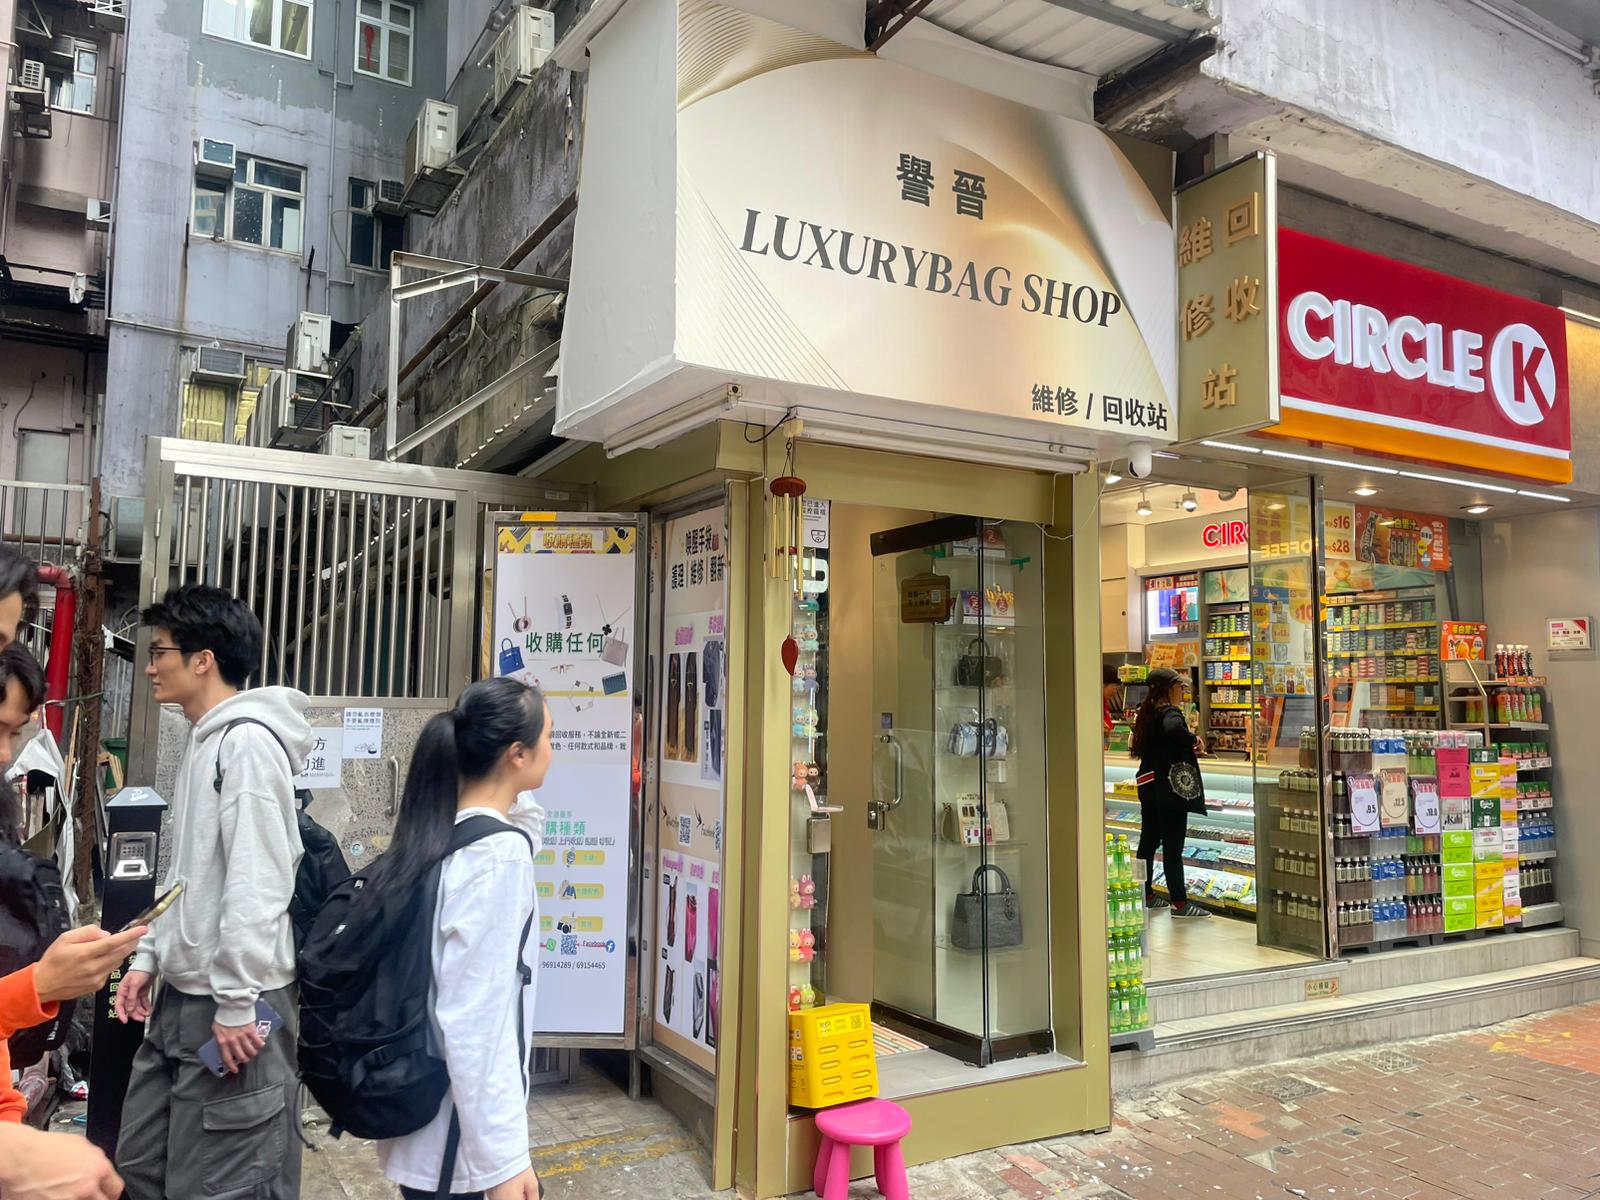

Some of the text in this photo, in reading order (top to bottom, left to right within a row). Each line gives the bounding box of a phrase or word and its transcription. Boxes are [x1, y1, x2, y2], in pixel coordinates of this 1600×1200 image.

[897, 153, 989, 221] 譽晉
[740, 208, 1122, 328] LUXURYBAG SHOP
[1178, 216, 1214, 342] 維修
[1223, 191, 1261, 324] 回收
[1286, 290, 1485, 393] CIRCLE
[1031, 384, 1079, 414] 維修
[1101, 395, 1169, 431] 回收站
[1201, 362, 1238, 410] 站
[1202, 519, 1249, 548] CIR
[525, 632, 605, 656] 收購任何
[313, 736, 327, 751] 方
